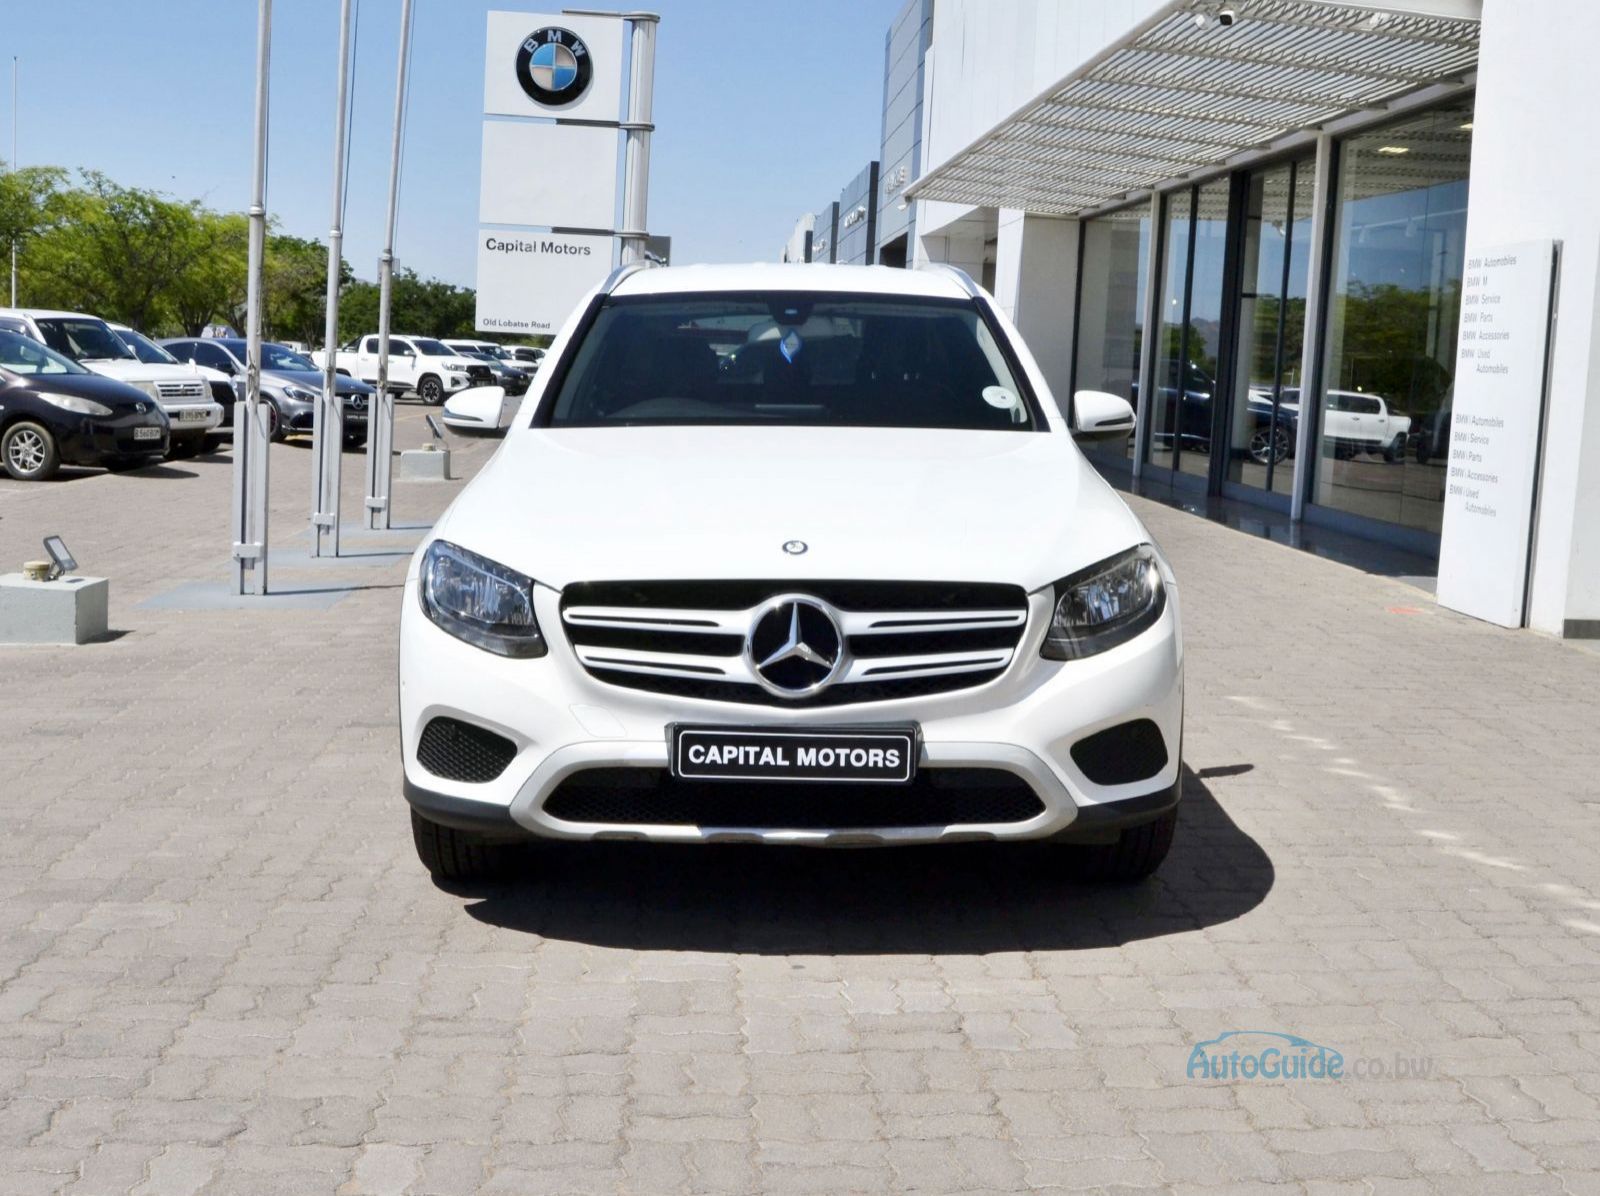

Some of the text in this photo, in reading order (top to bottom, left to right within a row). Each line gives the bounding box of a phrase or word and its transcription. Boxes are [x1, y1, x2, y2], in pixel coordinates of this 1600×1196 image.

[523, 29, 586, 57] BMW
[486, 237, 591, 255] Capital Motors
[1468, 254, 1517, 269] BMW Automobiles
[1467, 276, 1480, 287] BMW
[1465, 294, 1501, 305] BMW Service
[482, 318, 551, 329] Old Lobatse Road
[1464, 312, 1493, 323] BMW Parts
[1462, 330, 1510, 340] BMW Accessories
[1461, 348, 1491, 359] BMW Used
[1476, 364, 1508, 374] Automobiles
[1455, 414, 1468, 424] BMW
[1472, 415, 1504, 428] Automobiles
[1454, 432, 1467, 442] BMW
[1470, 433, 1490, 445] Service
[1452, 449, 1465, 460] BMW
[1468, 451, 1482, 462] Parts
[1451, 467, 1464, 478] BMW
[1467, 470, 1498, 483] Accessories
[1449, 484, 1463, 496] BMW
[1465, 488, 1480, 499] Used
[1465, 502, 1497, 517] Automobiles
[687, 744, 901, 768] CAPITAL MOTORS
